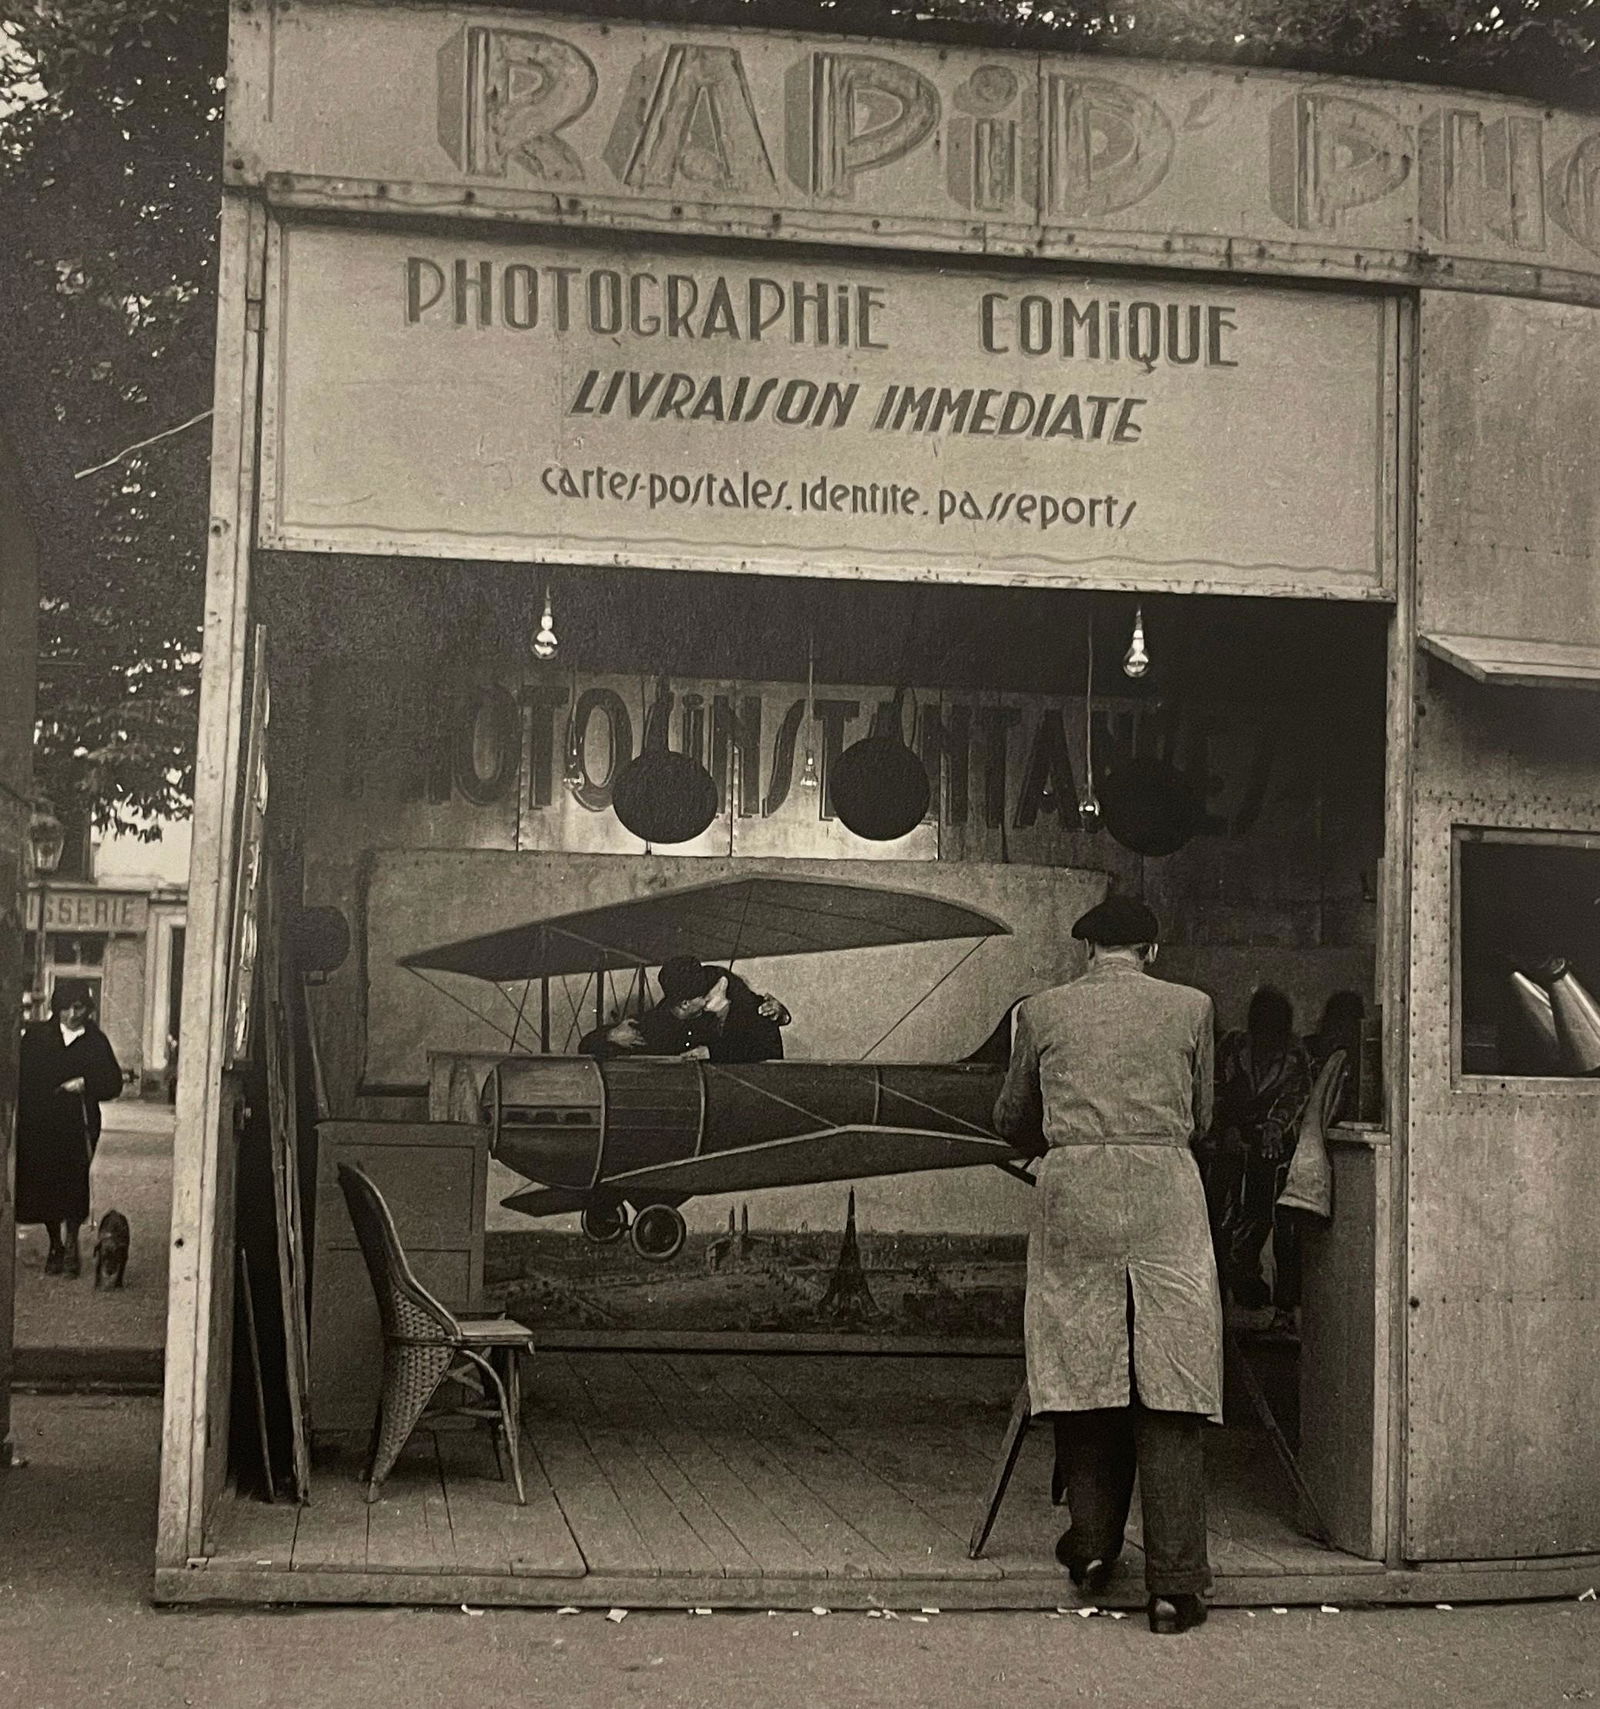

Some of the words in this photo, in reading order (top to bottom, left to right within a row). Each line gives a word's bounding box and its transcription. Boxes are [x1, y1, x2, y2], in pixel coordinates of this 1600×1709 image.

[405, 256, 889, 349] PHOTOGRAPHiE
[980, 293, 1239, 373] COMiQUE
[568, 369, 859, 430] LIVRAISON
[872, 384, 1147, 444] IMMEDIATE
[938, 489, 1137, 530] passeports
